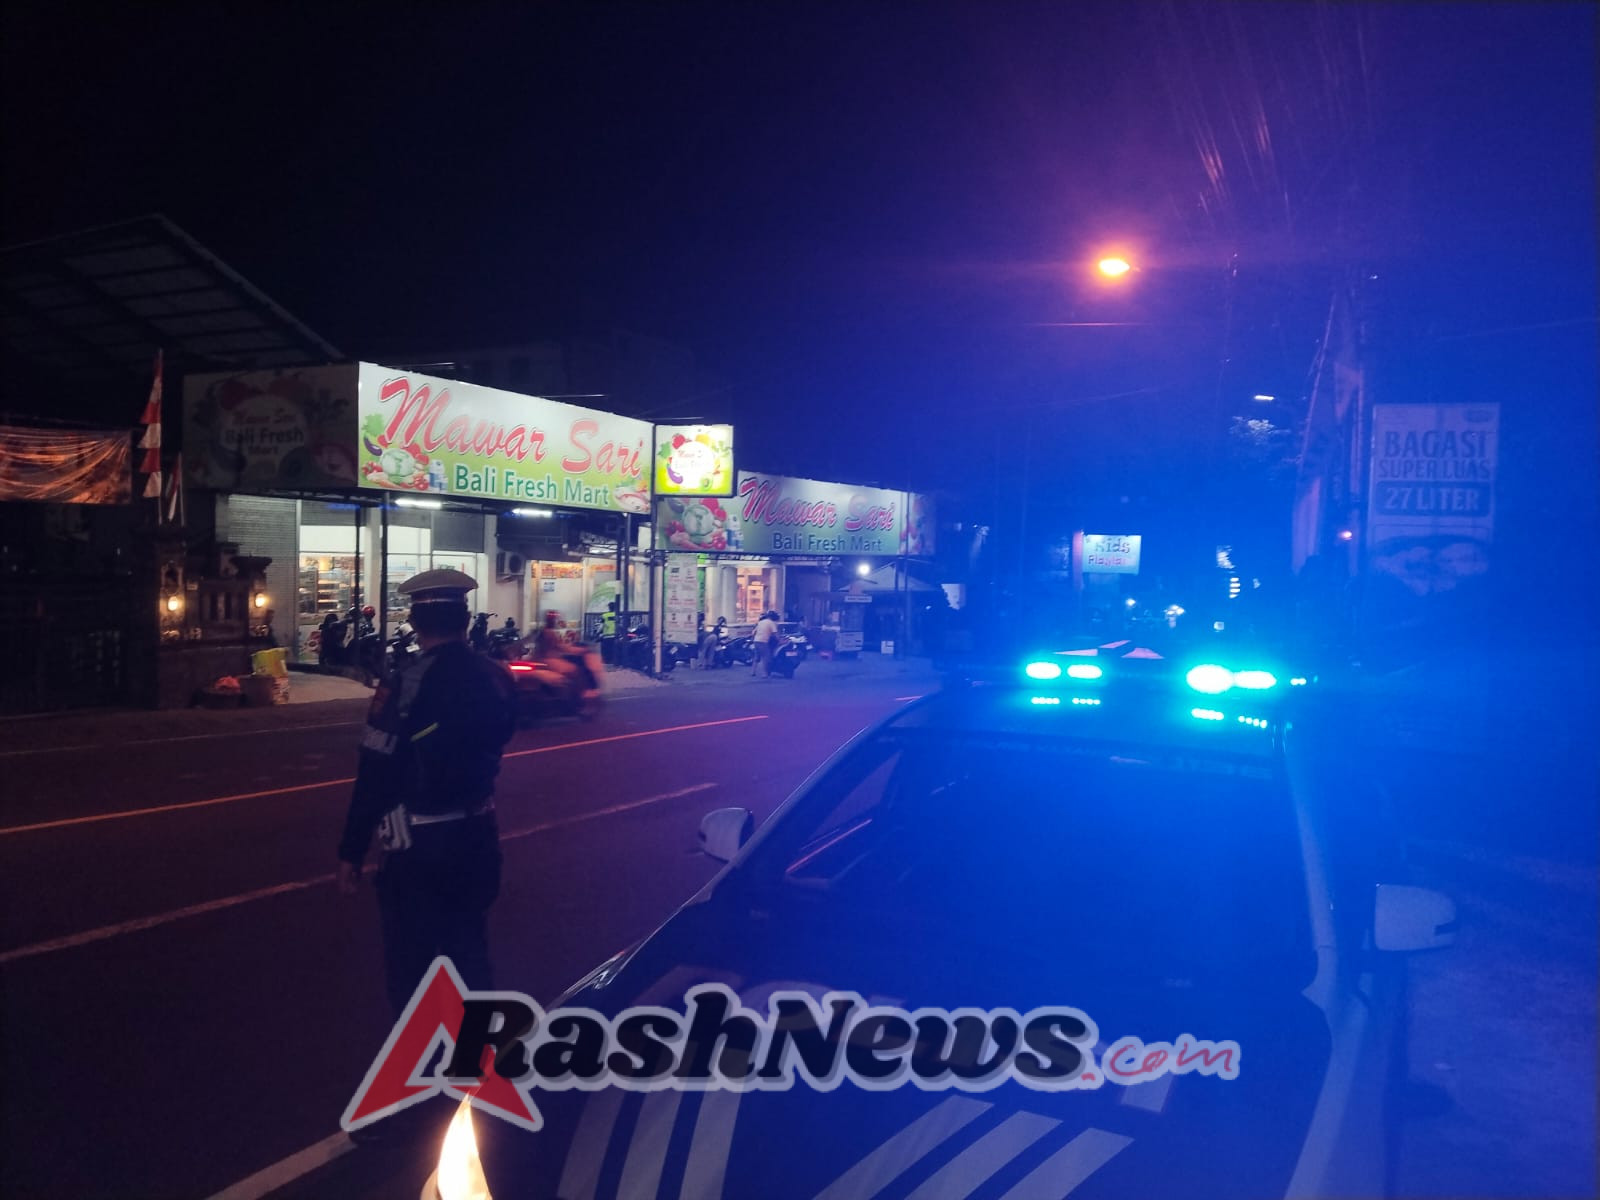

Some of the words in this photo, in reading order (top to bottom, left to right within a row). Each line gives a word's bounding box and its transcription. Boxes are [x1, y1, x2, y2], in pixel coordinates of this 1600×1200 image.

[225, 427, 254, 444] Bali
[260, 425, 304, 443] Fresh
[379, 376, 547, 464] Mawar
[561, 418, 644, 478] Sari
[1383, 430, 1488, 459] BAGASI
[1378, 459, 1437, 479] SUPER
[455, 465, 496, 494] Bali
[504, 471, 558, 501] Fresh
[564, 480, 609, 506] Mart
[1384, 486, 1413, 510] 27
[1415, 487, 1480, 511] LITER
[739, 477, 837, 528] Mawar
[844, 494, 896, 532] Sari
[773, 532, 802, 551] Bali
[808, 534, 846, 552] Fresh
[850, 537, 882, 552] Mart
